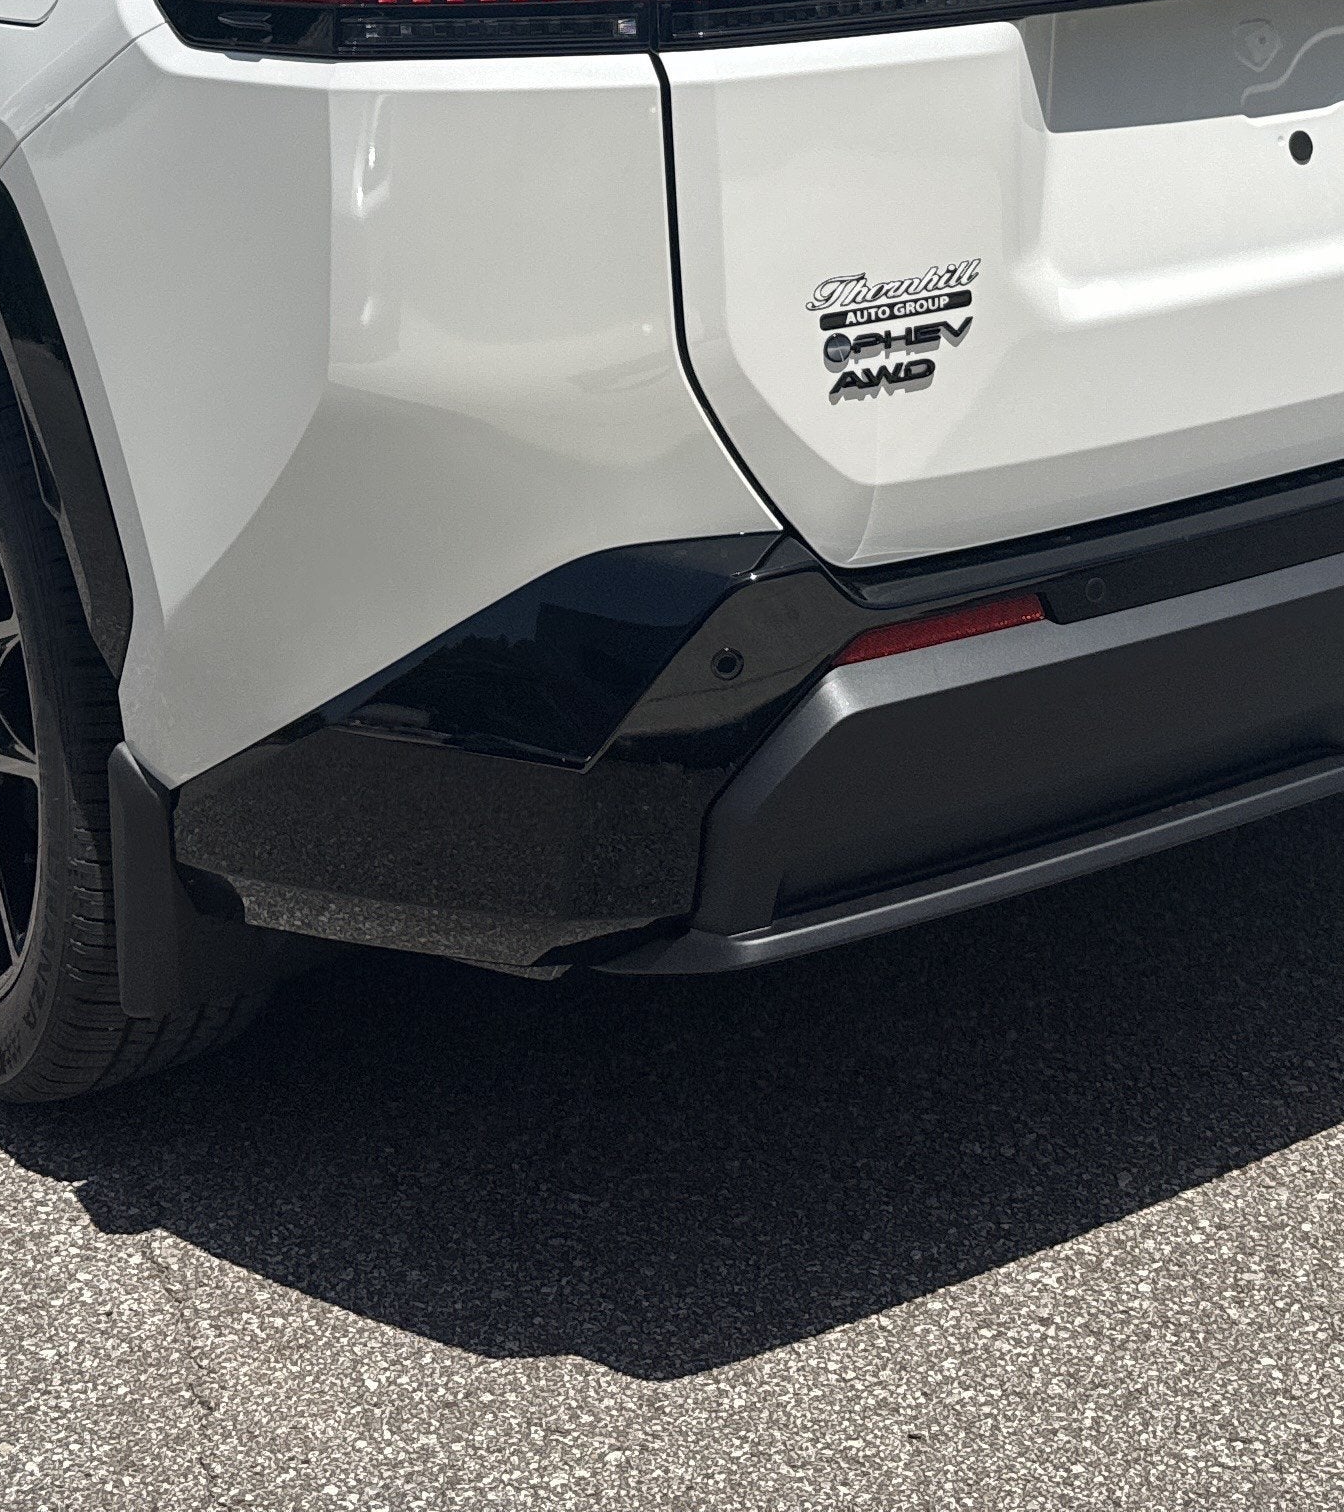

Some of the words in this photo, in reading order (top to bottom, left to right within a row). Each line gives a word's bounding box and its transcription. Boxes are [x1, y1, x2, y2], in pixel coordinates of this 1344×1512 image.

[806, 258, 981, 312] Thornhill
[845, 305, 891, 326] AUTO
[893, 295, 950, 316] GROUP
[852, 316, 974, 354] PHEV
[828, 358, 936, 396] AWD
